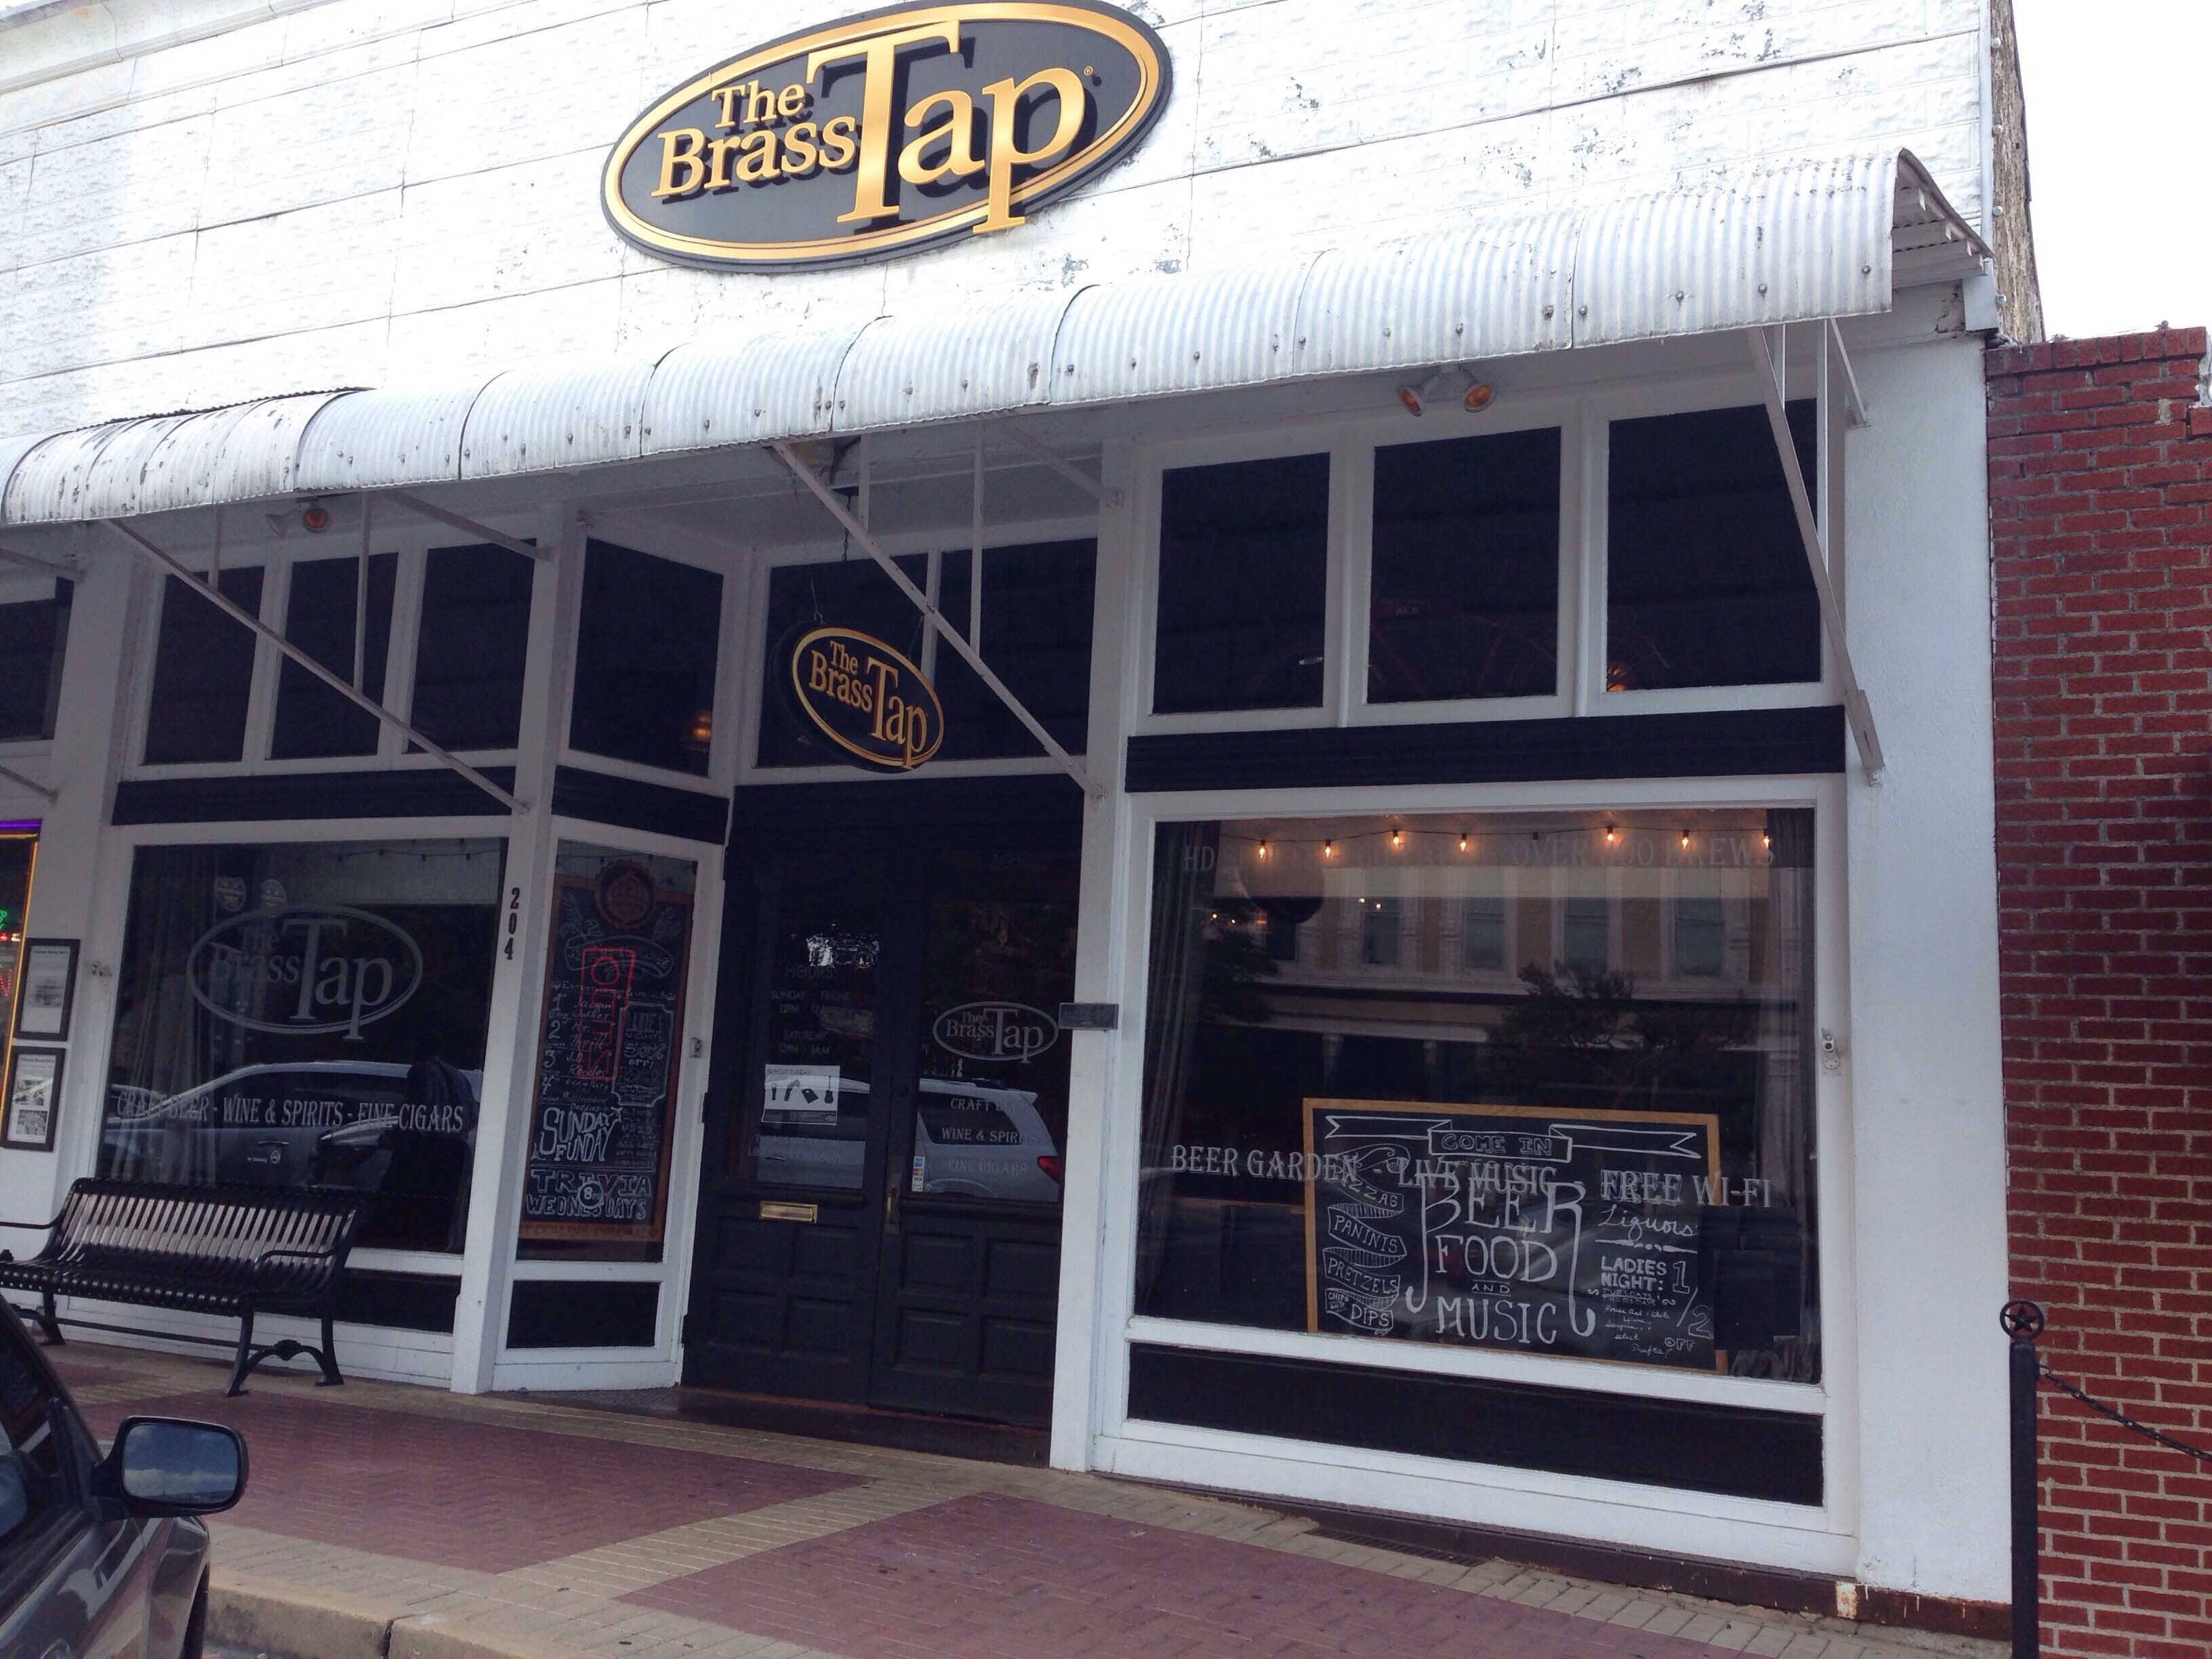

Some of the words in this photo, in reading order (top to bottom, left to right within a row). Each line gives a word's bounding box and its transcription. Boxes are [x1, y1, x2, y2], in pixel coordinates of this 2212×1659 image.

[712, 80, 806, 129] The
[651, 115, 857, 197] Brass
[806, 20, 1086, 233] Tap
[830, 640, 859, 674] The
[808, 650, 872, 713] Brass
[867, 657, 927, 771] Tap
[1511, 838, 1589, 867] OVER
[504, 887, 520, 960] 204
[283, 918, 394, 1042] Tap
[961, 1011, 983, 1024] The
[946, 1019, 996, 1039] Brass
[983, 1008, 1044, 1063] Tap
[223, 1093, 262, 1123] WINE
[265, 1098, 276, 1124] &
[281, 1100, 344, 1128] SPIRITS
[358, 1103, 396, 1128] FINE
[398, 1103, 465, 1134] CIGARS
[949, 1097, 993, 1113] CRAFT
[940, 1126, 971, 1141] WINE
[975, 1130, 985, 1142] &
[1441, 1132, 1507, 1155] COME
[1518, 1136, 1553, 1156] IN
[531, 1169, 653, 1198] TRIVIA
[1171, 1144, 1240, 1177] BEER
[1246, 1149, 1358, 1183] GARDEN
[1600, 1170, 1682, 1204] FREE
[1694, 1171, 1771, 1208] WI-FI
[1334, 1214, 1399, 1254] PANINIS
[1327, 1258, 1399, 1294] PRETZELS
[1435, 1234, 1557, 1284] FOOD
[1601, 1256, 1667, 1275] LADIES
[1471, 1283, 1511, 1295] AND
[1601, 1272, 1664, 1291] NIGHT:
[1350, 1304, 1390, 1328] DIPS
[1435, 1295, 1557, 1345] MUSIC
[1664, 1337, 1696, 1352] OFF
